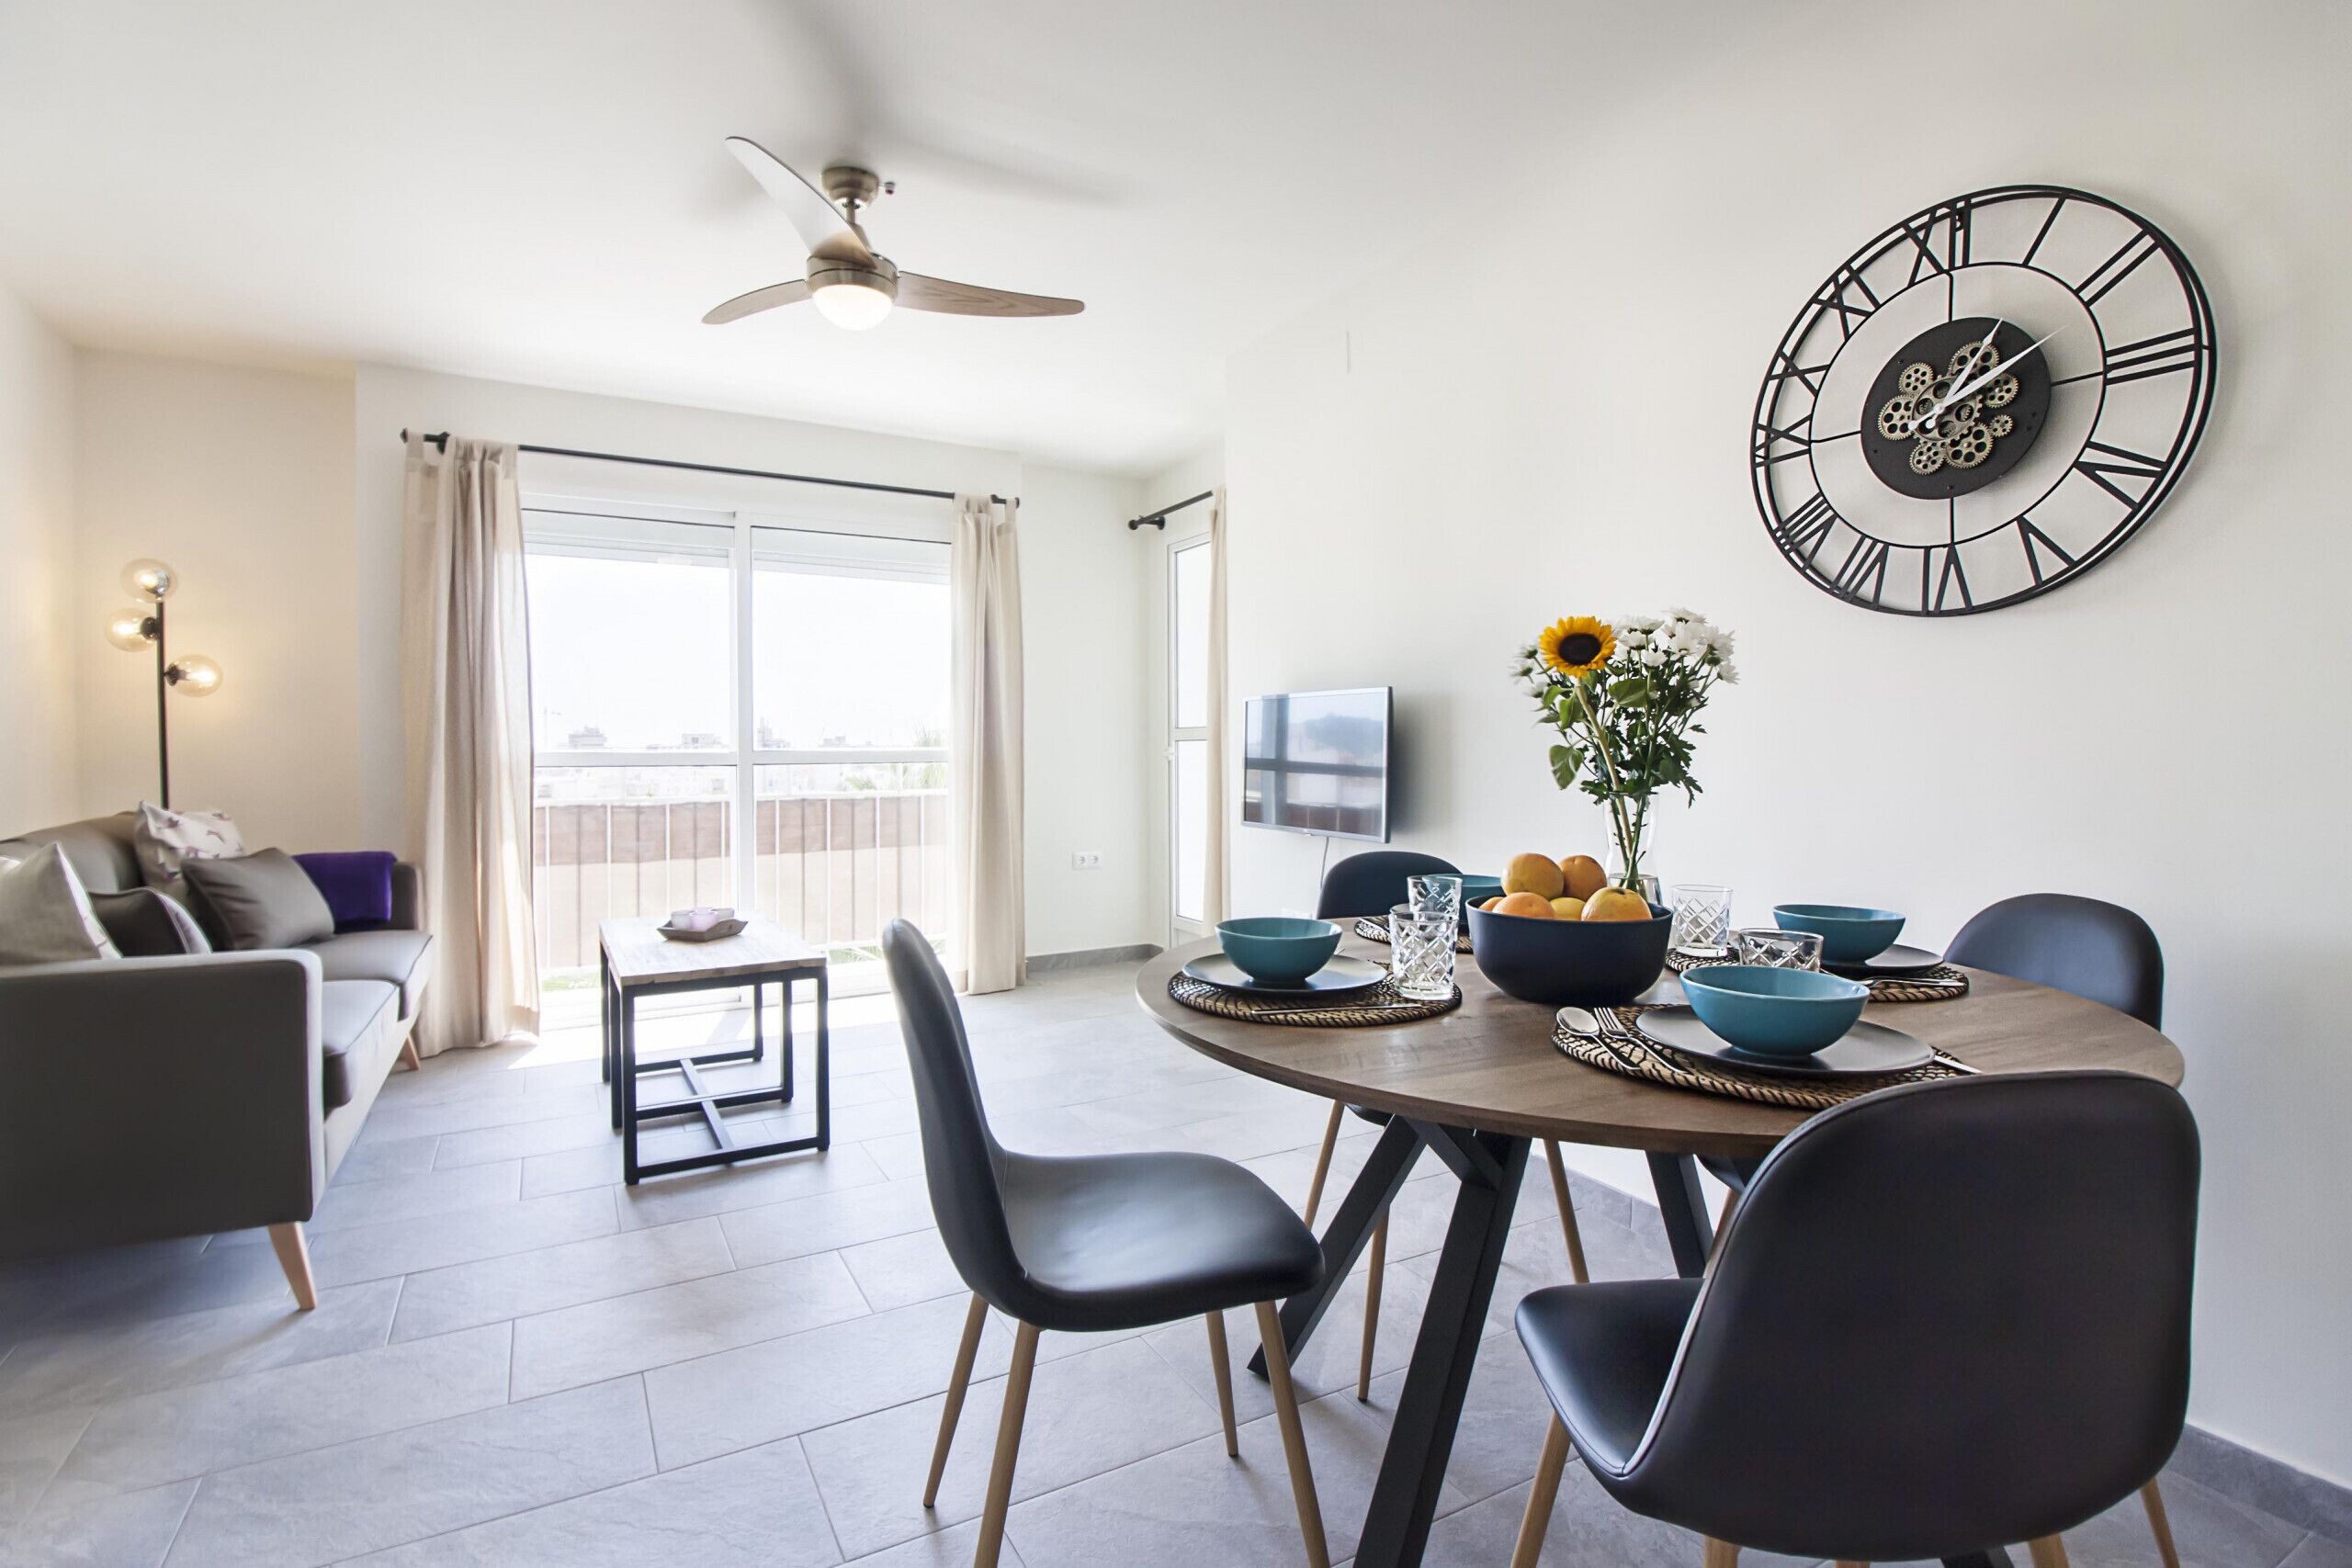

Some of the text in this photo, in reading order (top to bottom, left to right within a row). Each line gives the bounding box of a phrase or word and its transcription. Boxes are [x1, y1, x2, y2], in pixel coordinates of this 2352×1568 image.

[1902, 198, 1972, 287] XII
[2022, 192, 2067, 266] I
[1811, 263, 1881, 341] XI
[2075, 230, 2161, 308] II
[1767, 349, 1831, 398] X
[2104, 327, 2199, 386] III
[1753, 413, 1812, 468] IX
[2073, 440, 2167, 511] IV
[1773, 491, 1838, 571] VIII
[2016, 515, 2076, 587] V
[1829, 534, 1889, 609] VII
[1922, 543, 1973, 615] VI
